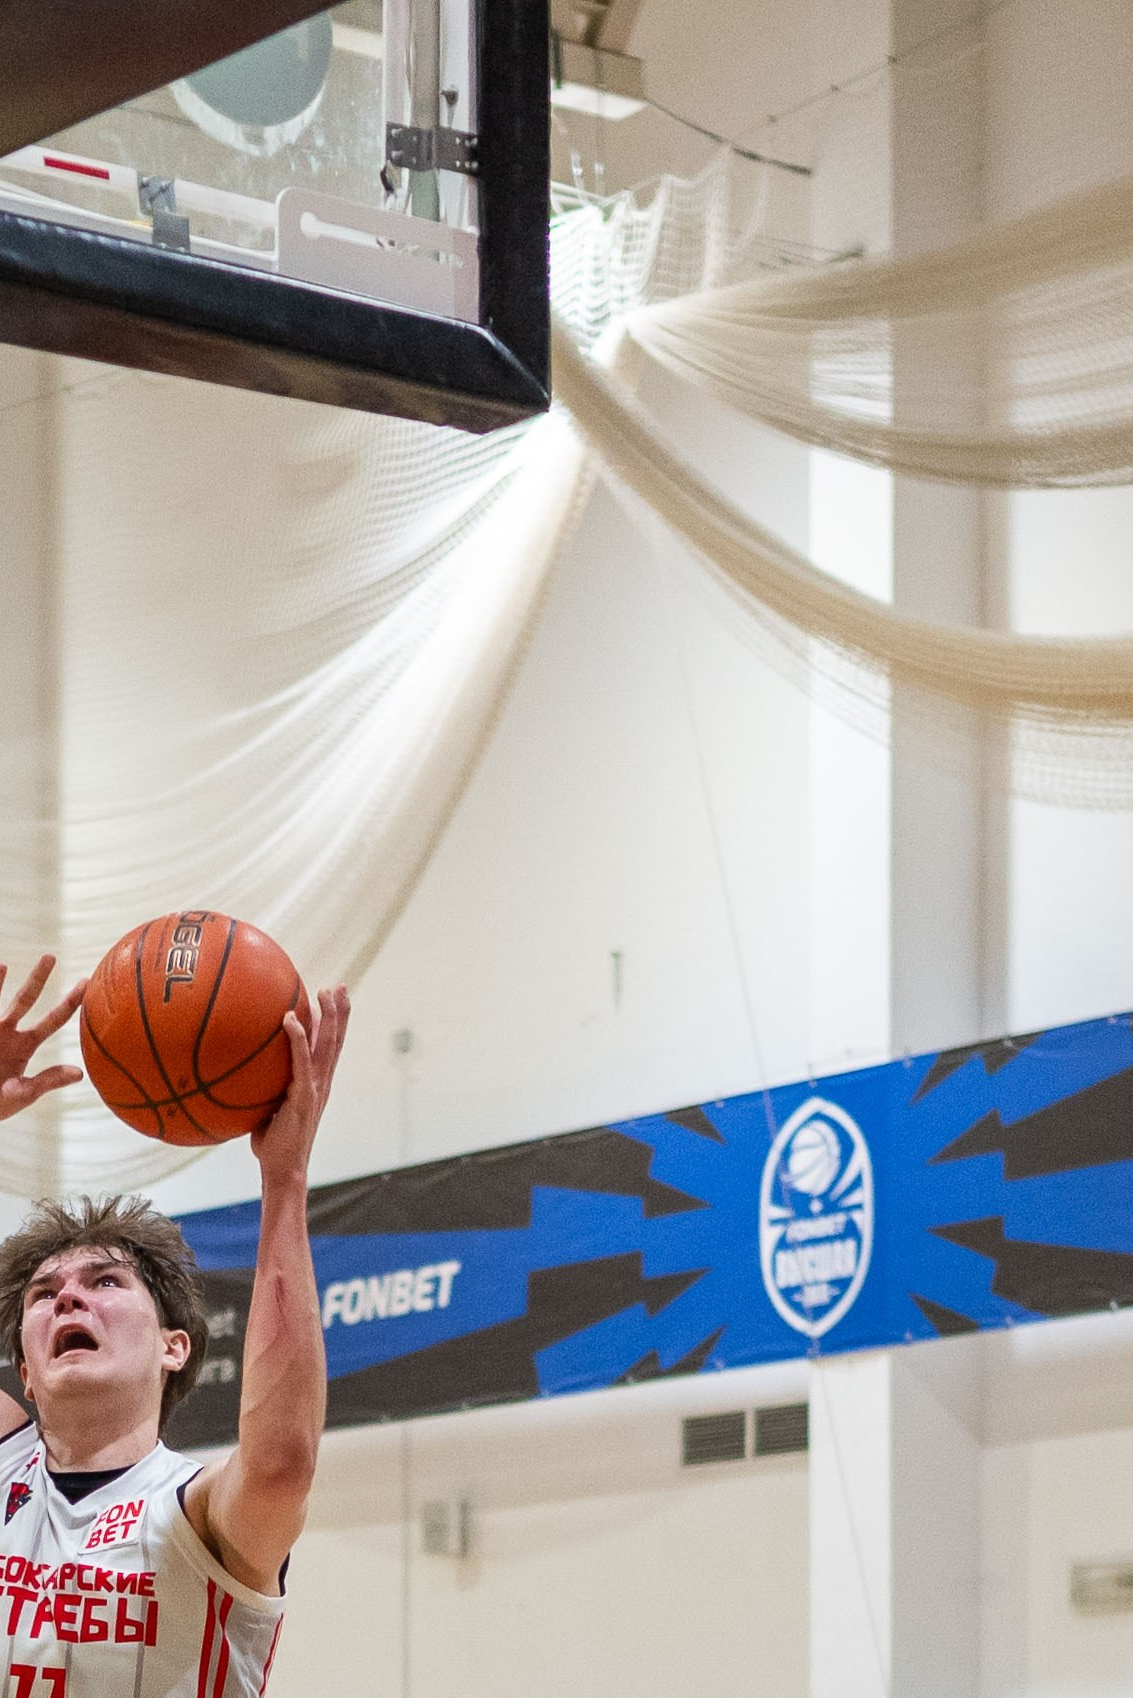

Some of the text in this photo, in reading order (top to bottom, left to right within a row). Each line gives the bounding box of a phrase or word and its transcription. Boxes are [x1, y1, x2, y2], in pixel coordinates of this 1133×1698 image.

[323, 1260, 461, 1329] FONBET
[94, 1499, 144, 1528] FON
[85, 1519, 137, 1549] BET
